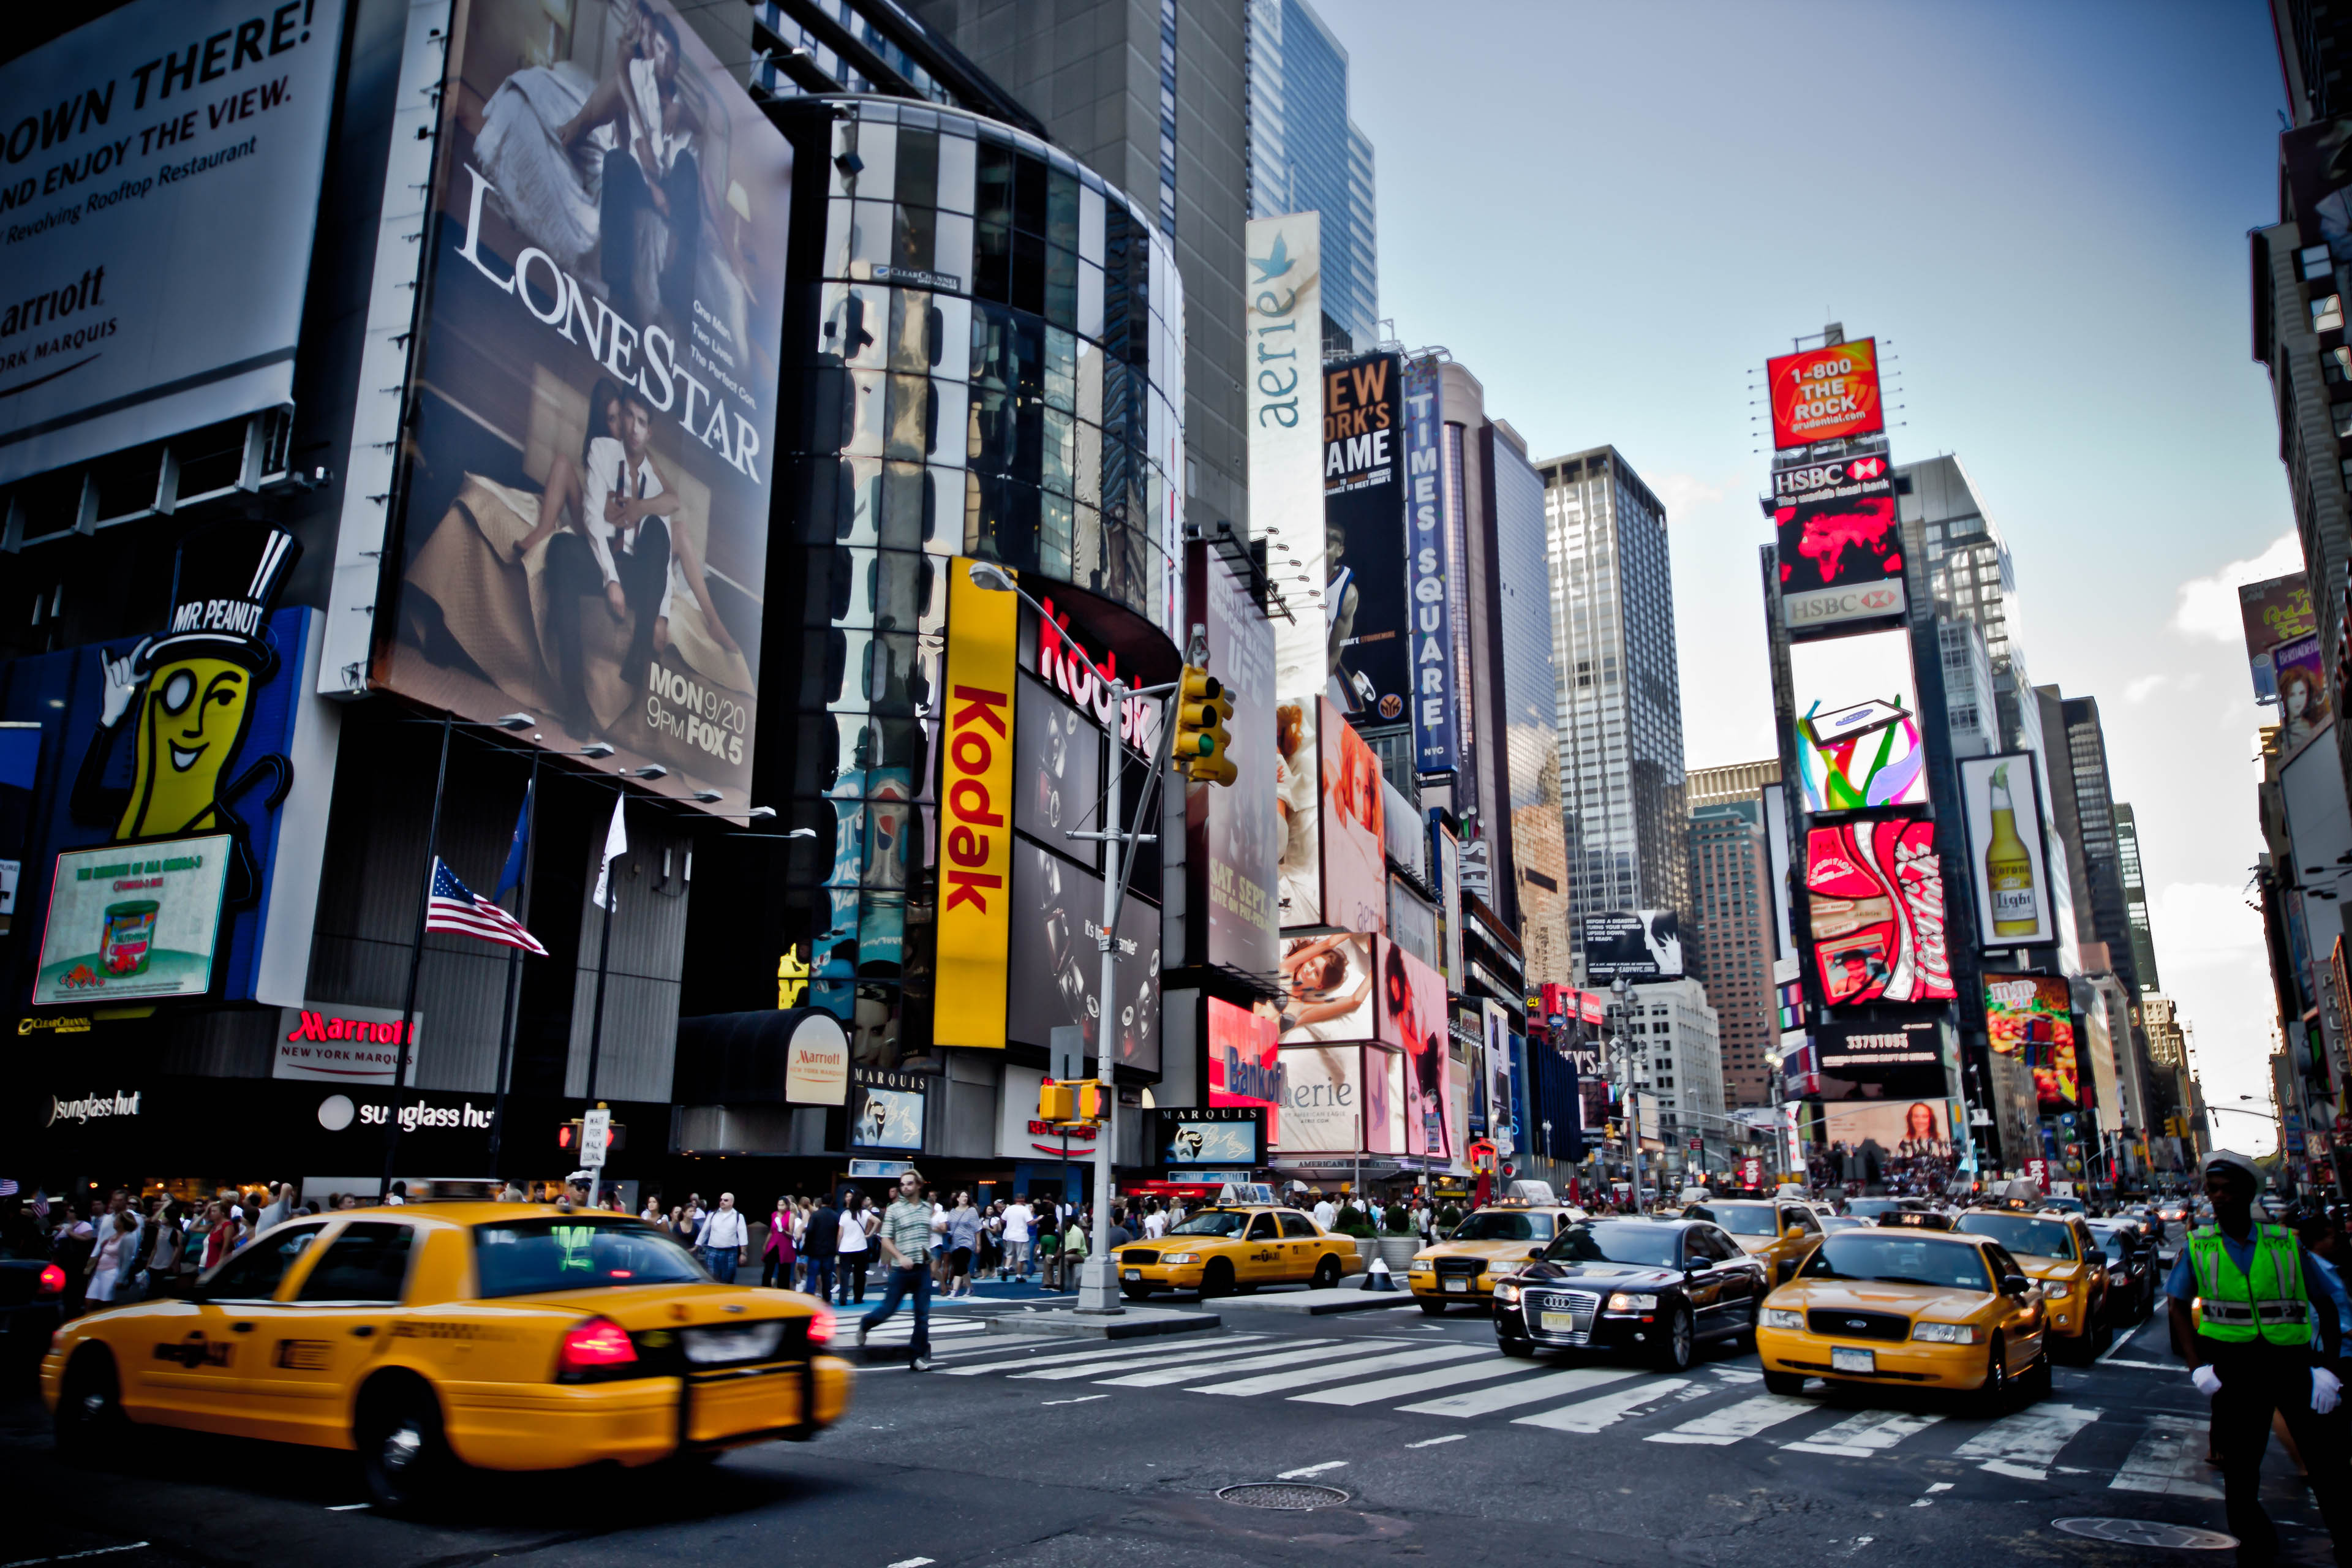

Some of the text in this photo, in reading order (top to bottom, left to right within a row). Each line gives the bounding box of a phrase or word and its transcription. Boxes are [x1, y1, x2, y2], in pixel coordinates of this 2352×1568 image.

[0, 0, 315, 164] OWN THERE!
[43, 136, 131, 195] ENJOY
[140, 111, 198, 156] THE
[208, 75, 292, 130] VIEW.
[7, 135, 258, 244] Revolving Rooftop Restaurant
[693, 300, 711, 323] One
[34, 317, 118, 360] MARQUIS
[692, 320, 710, 346] Two
[690, 344, 707, 367] The
[709, 360, 737, 393] Perfect
[1255, 287, 1299, 429] aerie
[1791, 358, 1852, 385] 1-800
[1801, 377, 1846, 401] THE
[1792, 410, 1866, 433] prudential.com
[1794, 393, 1857, 421] ROCK
[1775, 464, 1844, 495] HSBC
[1776, 495, 1797, 507] The
[1862, 478, 1890, 493] bank
[1408, 392, 1444, 726] TIMES SQUARE
[171, 598, 263, 637] MR. PEANUT
[1790, 593, 1858, 620] HSBC
[1039, 595, 1152, 759] Kodak
[649, 662, 745, 735] MON 9/20
[647, 696, 744, 766] 9PM FOX 5
[1423, 745, 1444, 756] NYC
[946, 684, 1008, 915] Kodak
[1989, 864, 2030, 877] Corona
[1210, 857, 1235, 897] SAT.
[1239, 875, 1268, 917] SEPT.
[1210, 885, 1227, 908] LIVE
[1228, 896, 1239, 916] ON
[1996, 891, 2031, 909] Light
[287, 1010, 415, 1046] Marriott
[2322, 972, 2352, 1096] PALAC
[281, 1046, 413, 1065] NEW YORK MARQUS
[795, 1049, 840, 1065] Marriott
[854, 1068, 925, 1089] MARQUIS
[1224, 1046, 1265, 1100] Bank
[56, 1090, 141, 1125] sunglass hut
[1284, 1076, 1352, 1109] aerie
[589, 1117, 604, 1125] WAIT
[864, 1094, 886, 1125] Come
[1163, 1108, 1257, 1120] MARQUIS
[586, 1140, 602, 1149] WALK
[589, 1128, 601, 1137] FOR
[1175, 1123, 1251, 1159] Come Fly Away
[583, 1153, 601, 1161] SIGNAL
